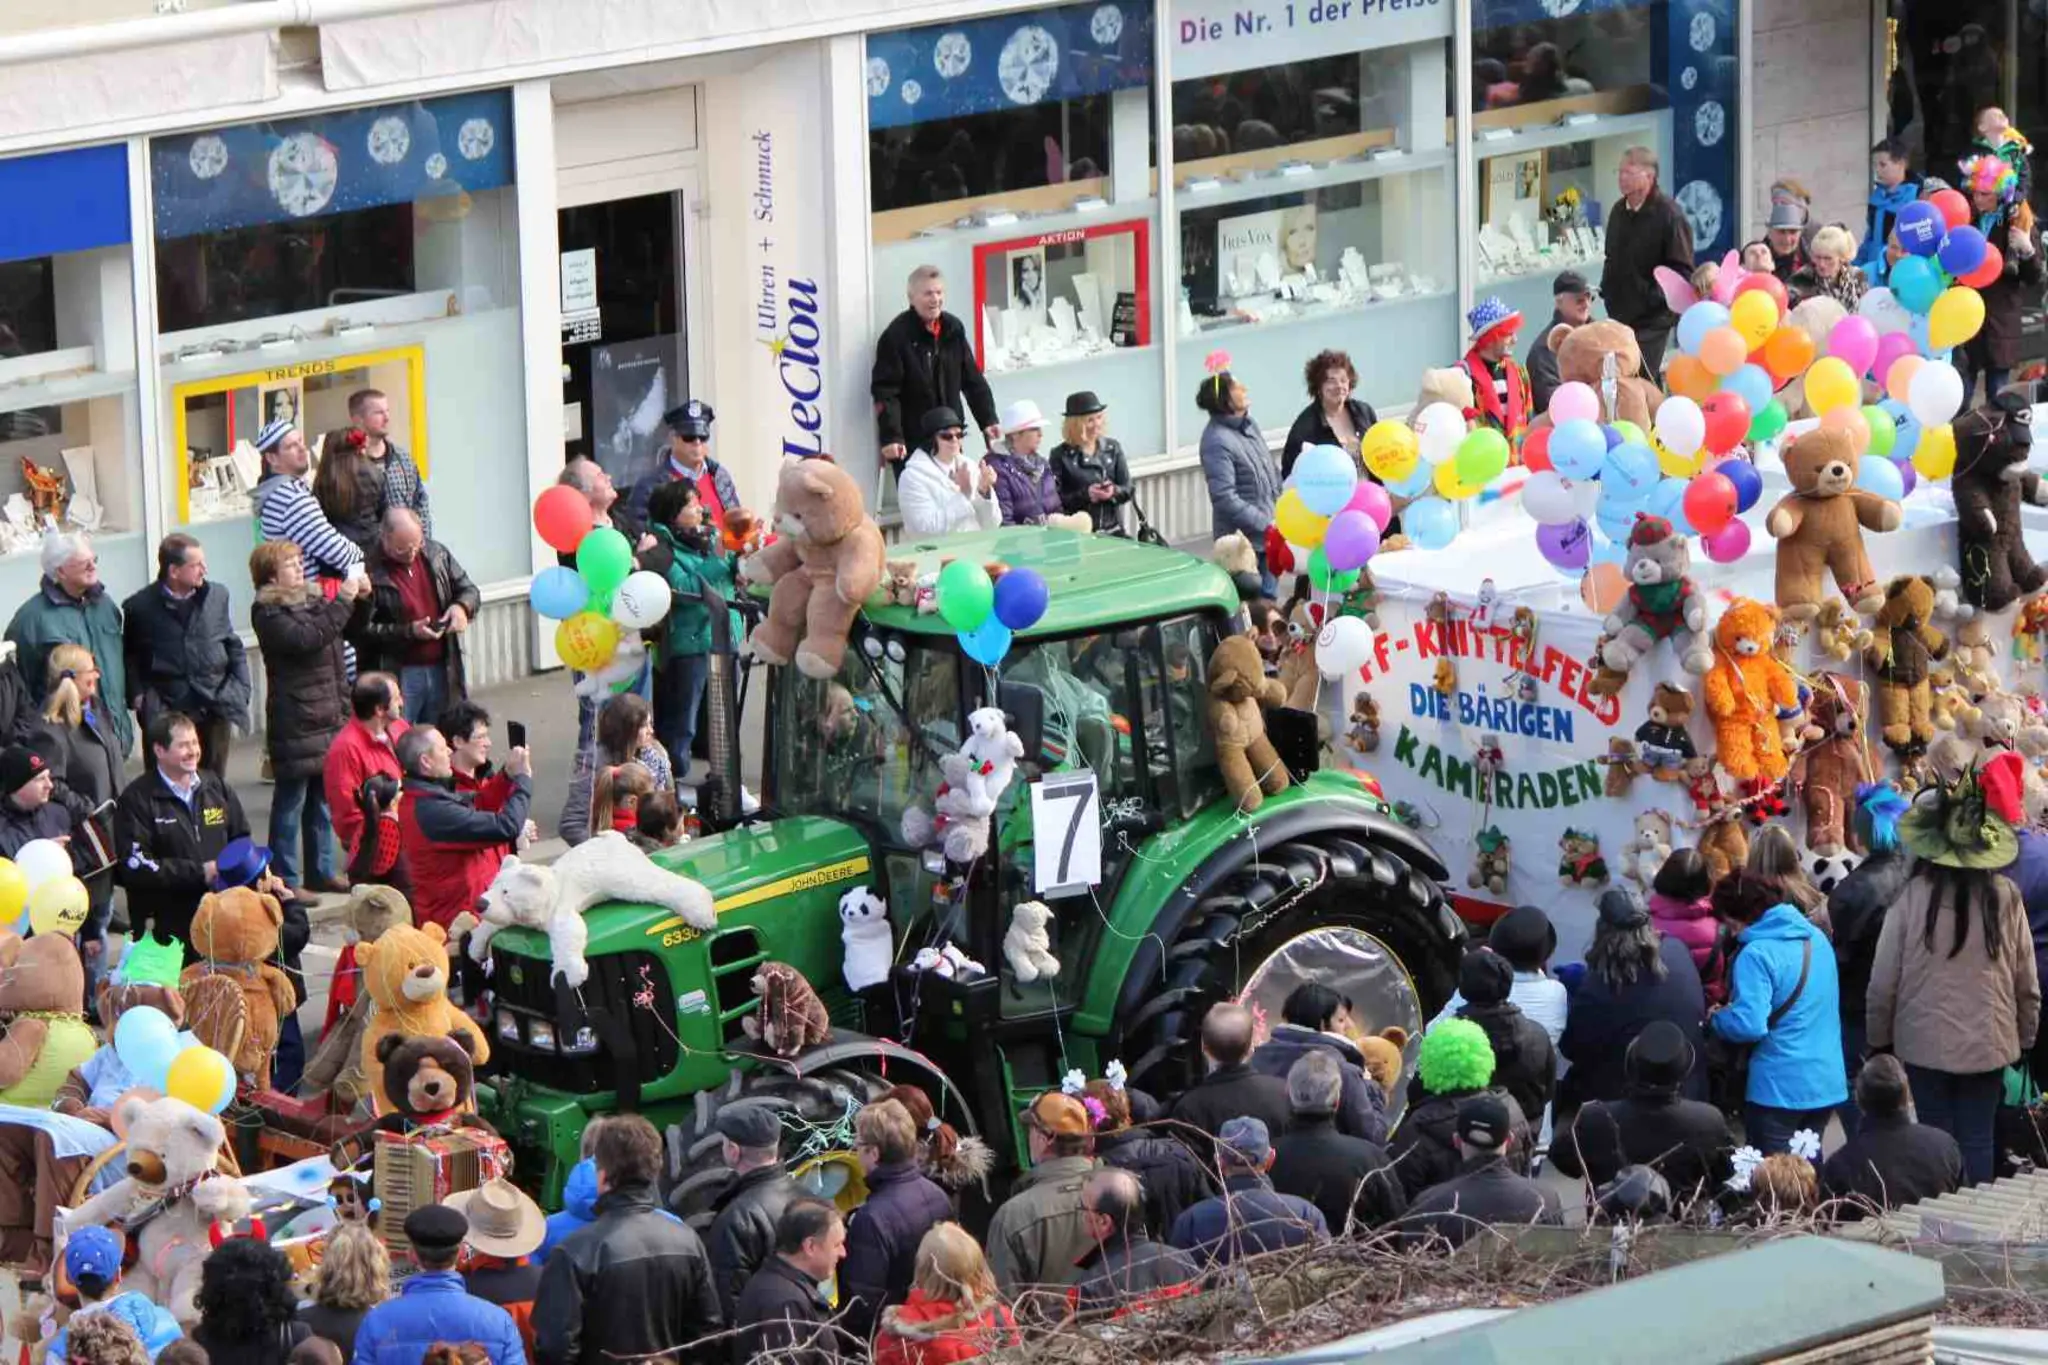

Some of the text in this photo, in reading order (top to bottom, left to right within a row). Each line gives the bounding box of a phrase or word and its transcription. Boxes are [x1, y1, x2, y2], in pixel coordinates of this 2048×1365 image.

[1179, 18, 1223, 44] Die
[1234, 10, 1272, 37] Nr.
[1286, 5, 1295, 27] 1
[1308, 0, 1352, 24] der
[752, 128, 774, 223] Schmuck
[1039, 230, 1086, 245] AKTION
[757, 264, 777, 330] Uhren
[266, 361, 334, 380] TRENDS
[780, 277, 822, 460] LeClou
[1410, 682, 1575, 744] DIE BÄRIGEN
[1394, 724, 1602, 810] KAMERADEN
[1042, 782, 1094, 884] 7
[663, 927, 700, 947] 6330
